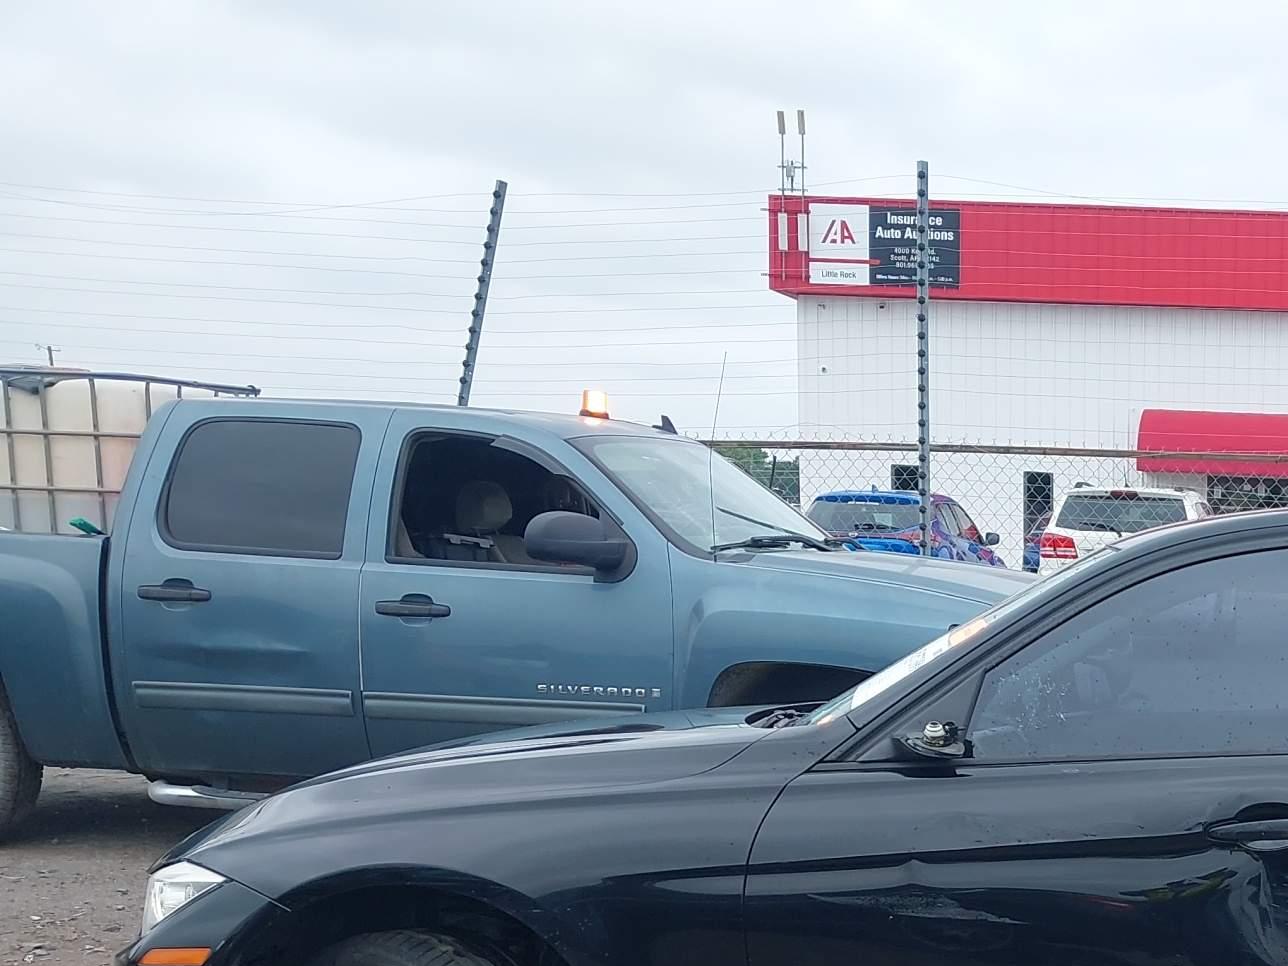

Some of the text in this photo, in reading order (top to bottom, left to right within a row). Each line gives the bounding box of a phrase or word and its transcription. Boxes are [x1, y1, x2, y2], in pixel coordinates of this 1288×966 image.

[875, 226, 901, 239] Auto
[821, 270, 857, 279] Little Rock
[536, 684, 645, 698] SILVERADO
